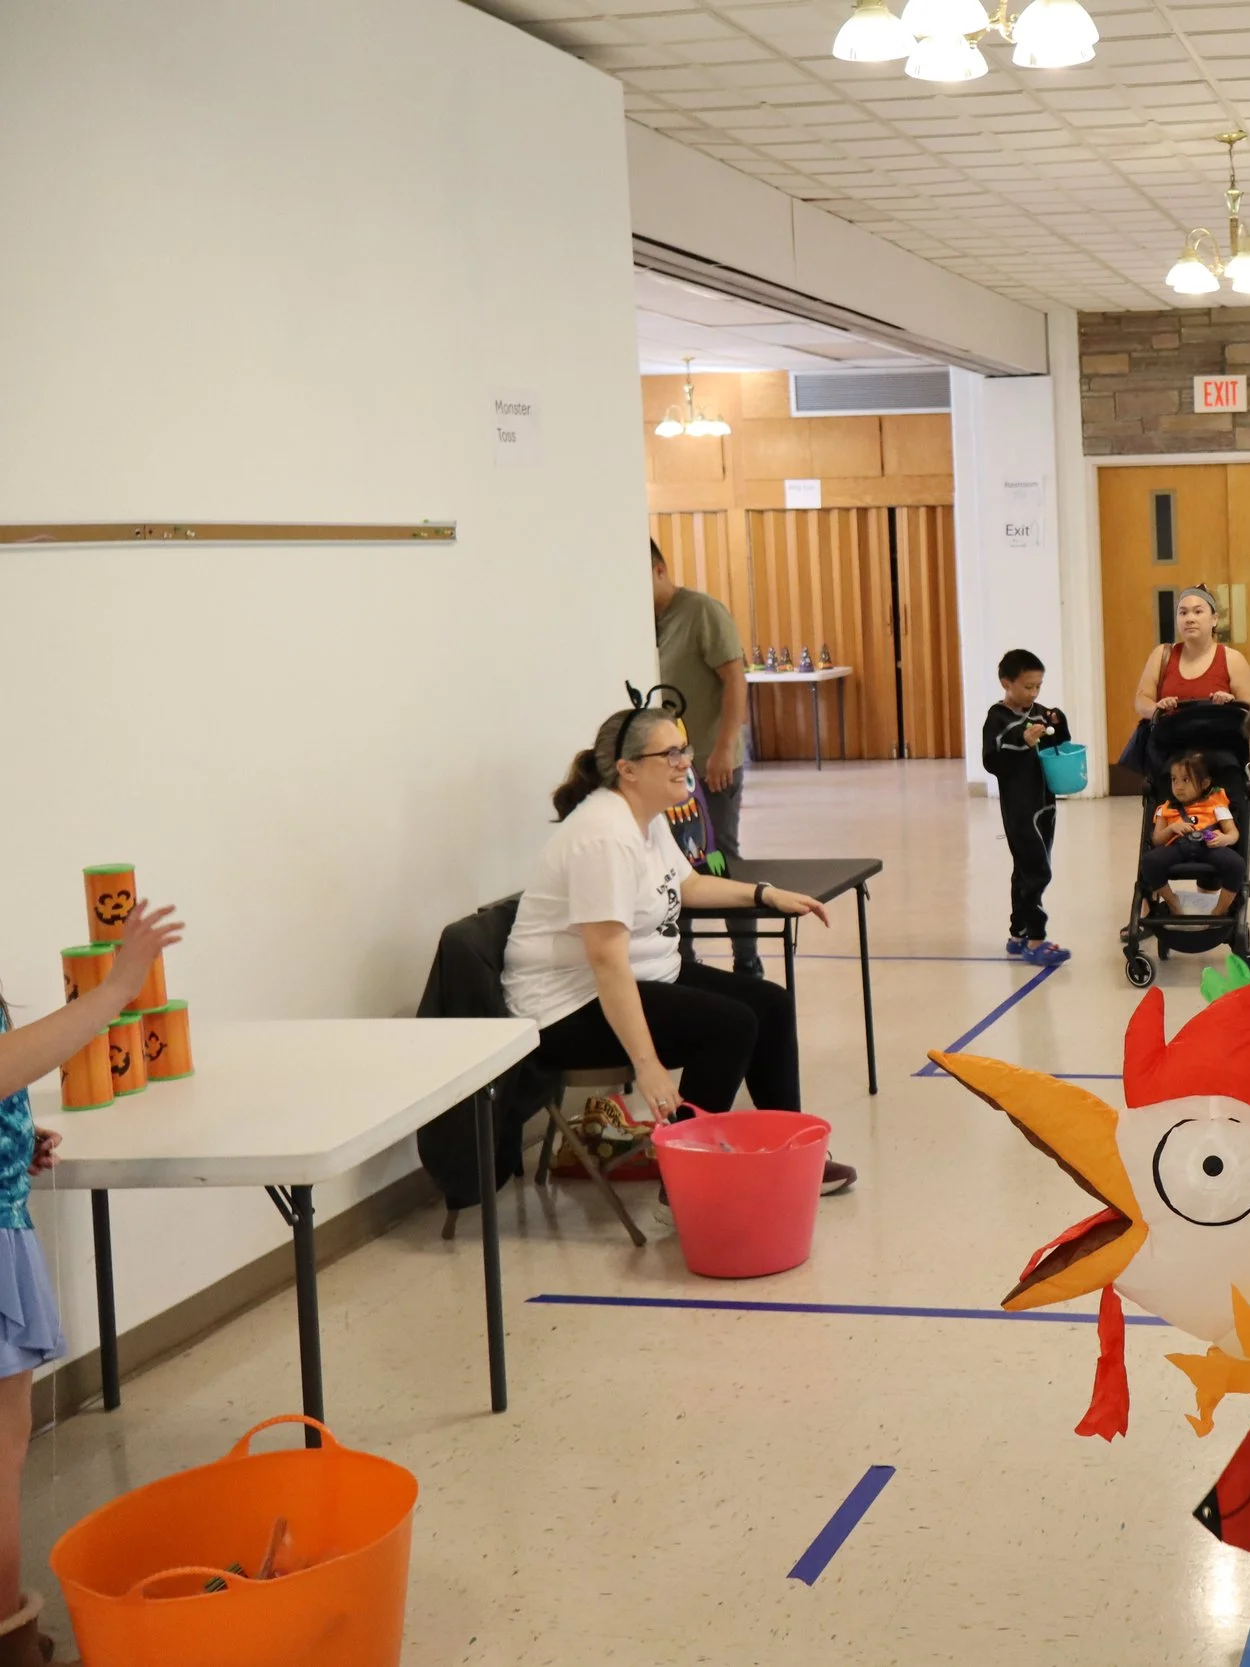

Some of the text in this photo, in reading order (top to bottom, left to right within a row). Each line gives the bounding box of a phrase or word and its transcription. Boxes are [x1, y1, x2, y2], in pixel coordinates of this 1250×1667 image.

[1203, 381, 1238, 407] EXIT
[495, 399, 531, 416] Monster
[497, 427, 517, 443] Toss
[1005, 523, 1030, 537] Exit
